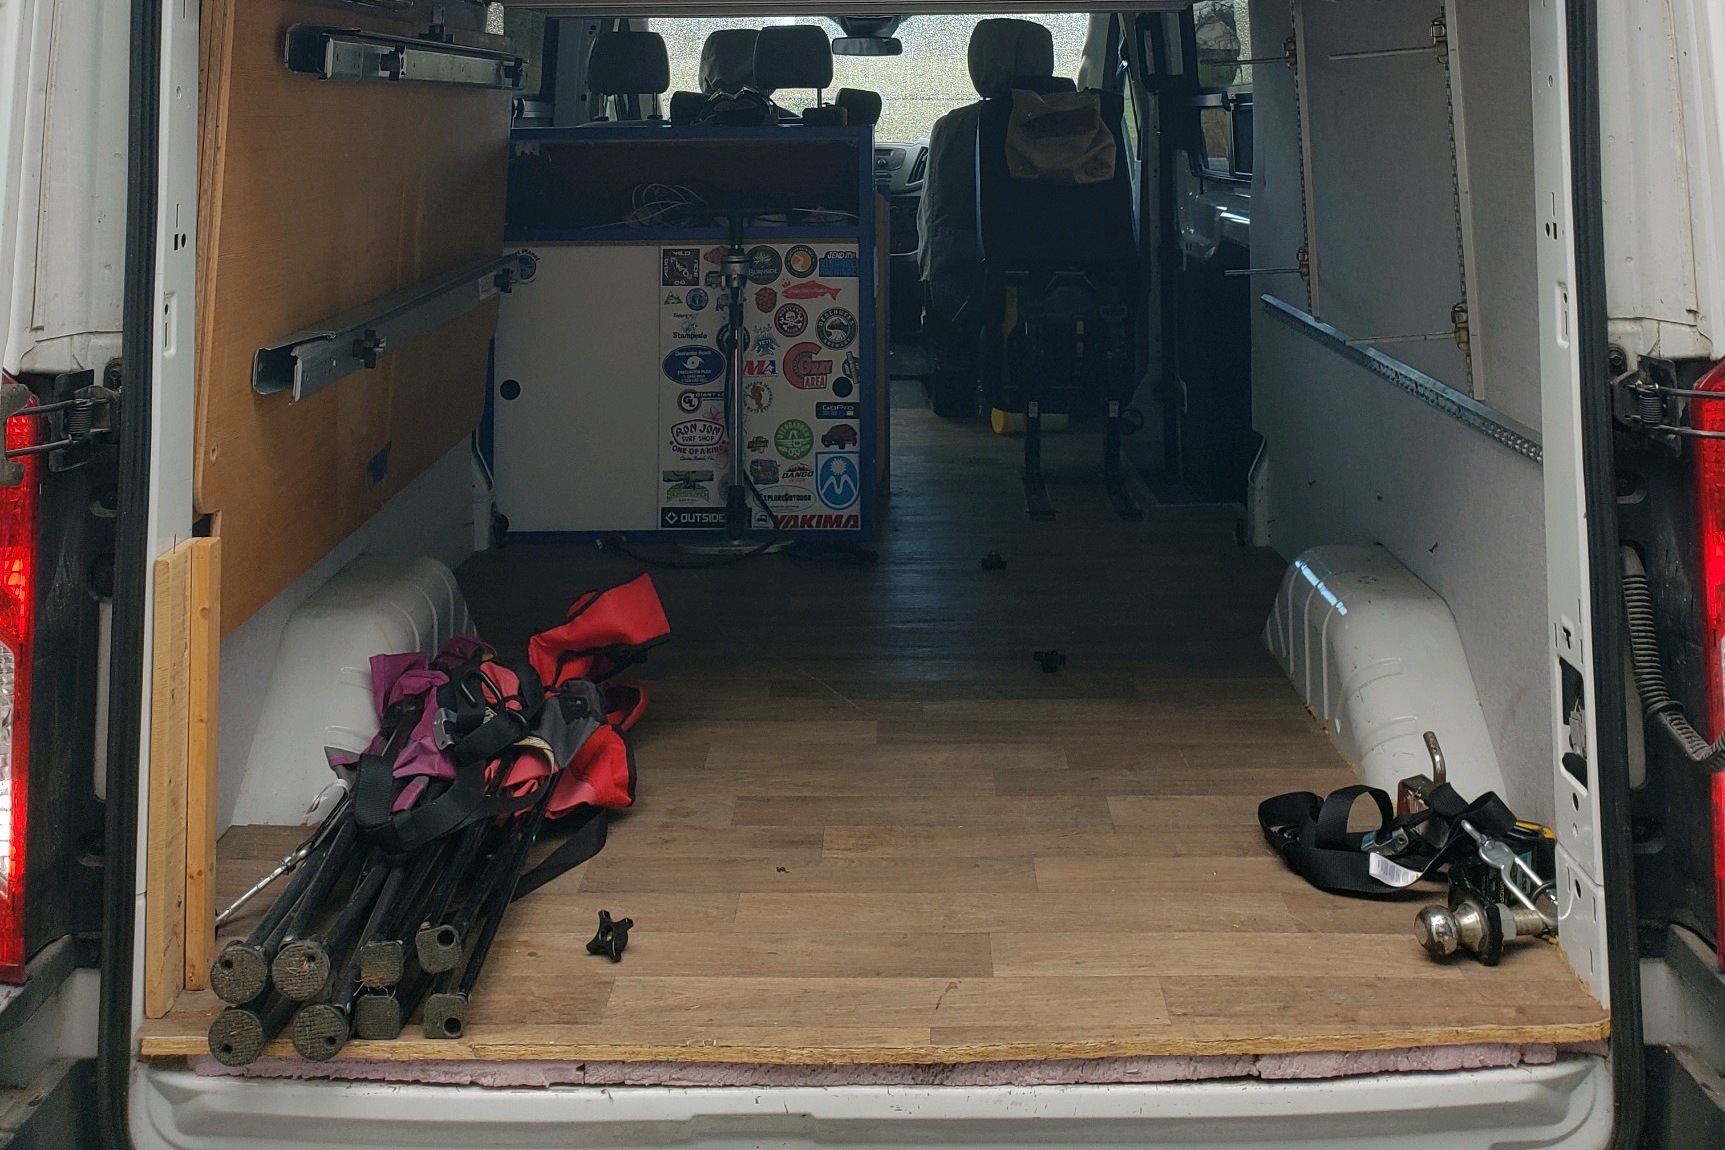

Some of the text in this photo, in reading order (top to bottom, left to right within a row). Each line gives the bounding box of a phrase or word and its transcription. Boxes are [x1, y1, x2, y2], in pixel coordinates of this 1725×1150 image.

[675, 423, 721, 438] RON JON
[672, 445, 687, 455] ONE
[688, 447, 698, 455] OF
[680, 513, 725, 523] OUTSIDE
[777, 514, 859, 529] YAKIMA
